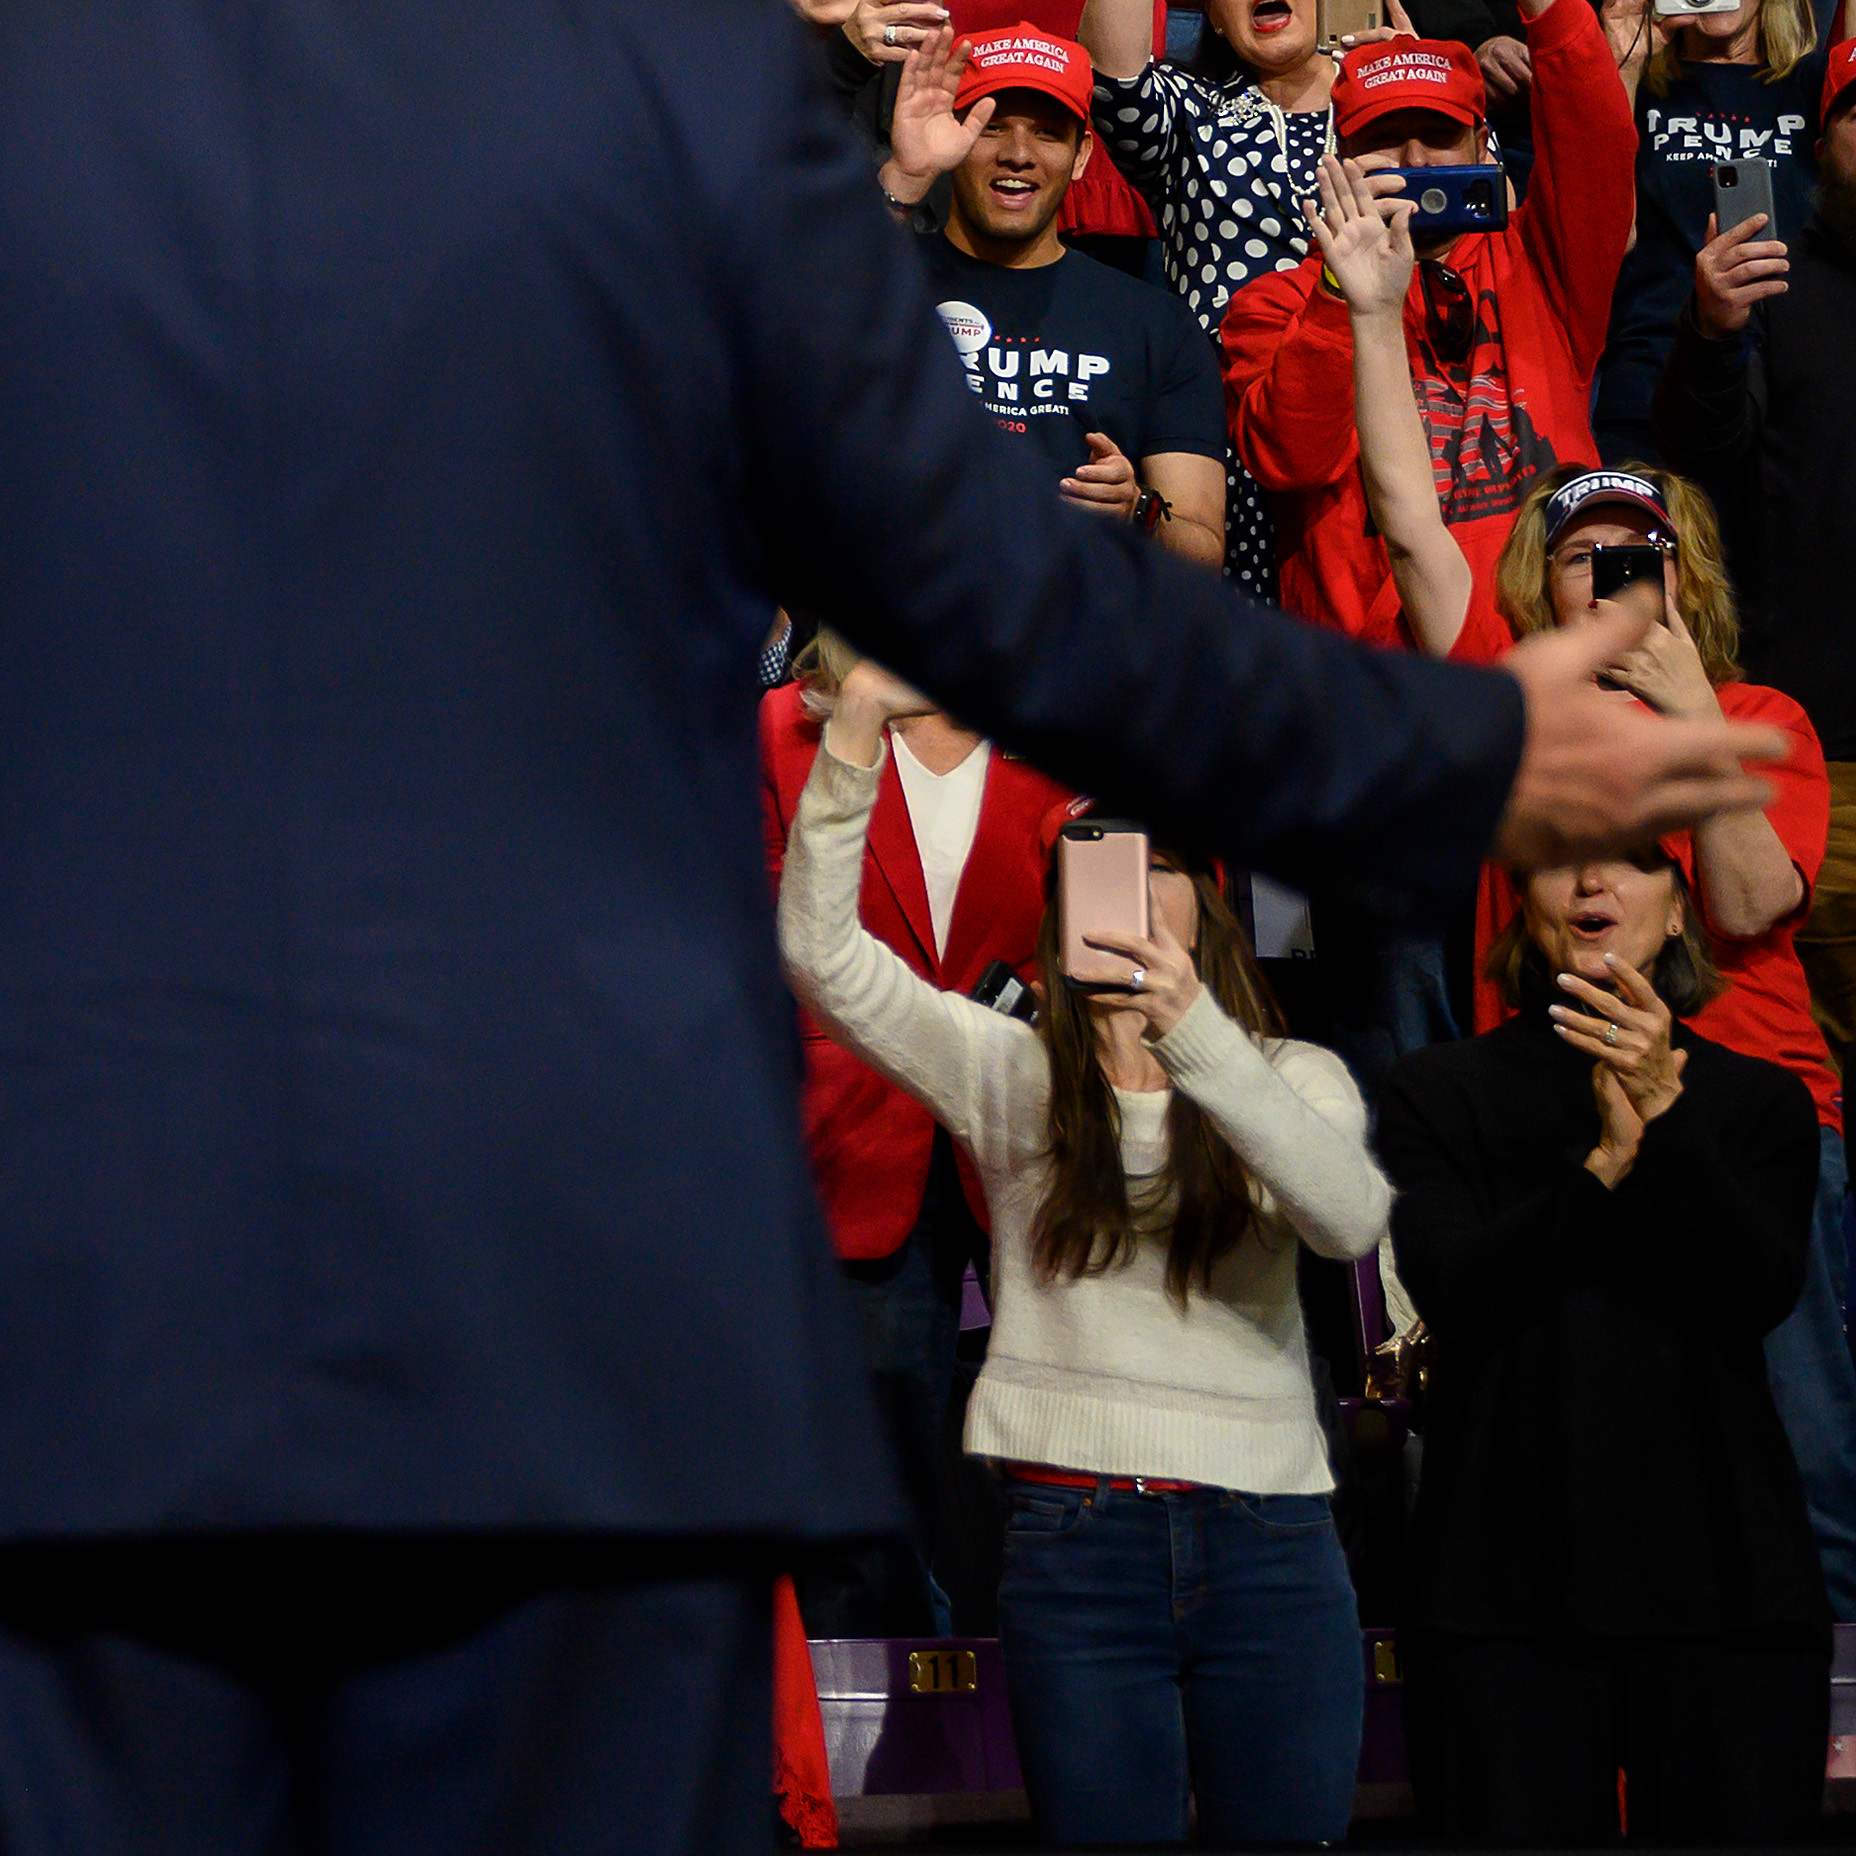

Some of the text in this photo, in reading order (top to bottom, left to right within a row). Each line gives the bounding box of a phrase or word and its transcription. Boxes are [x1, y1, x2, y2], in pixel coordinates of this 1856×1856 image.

[972, 36, 1069, 63] MAKE AMERICA
[980, 52, 1065, 74] GREAT AGAIN
[1356, 54, 1451, 79] MAKE AMERICA
[1363, 66, 1449, 86] GREAT AGAIN
[1646, 107, 1806, 151] TRUMP
[1556, 477, 1652, 506] TRUMP
[928, 1654, 958, 1689] 11
